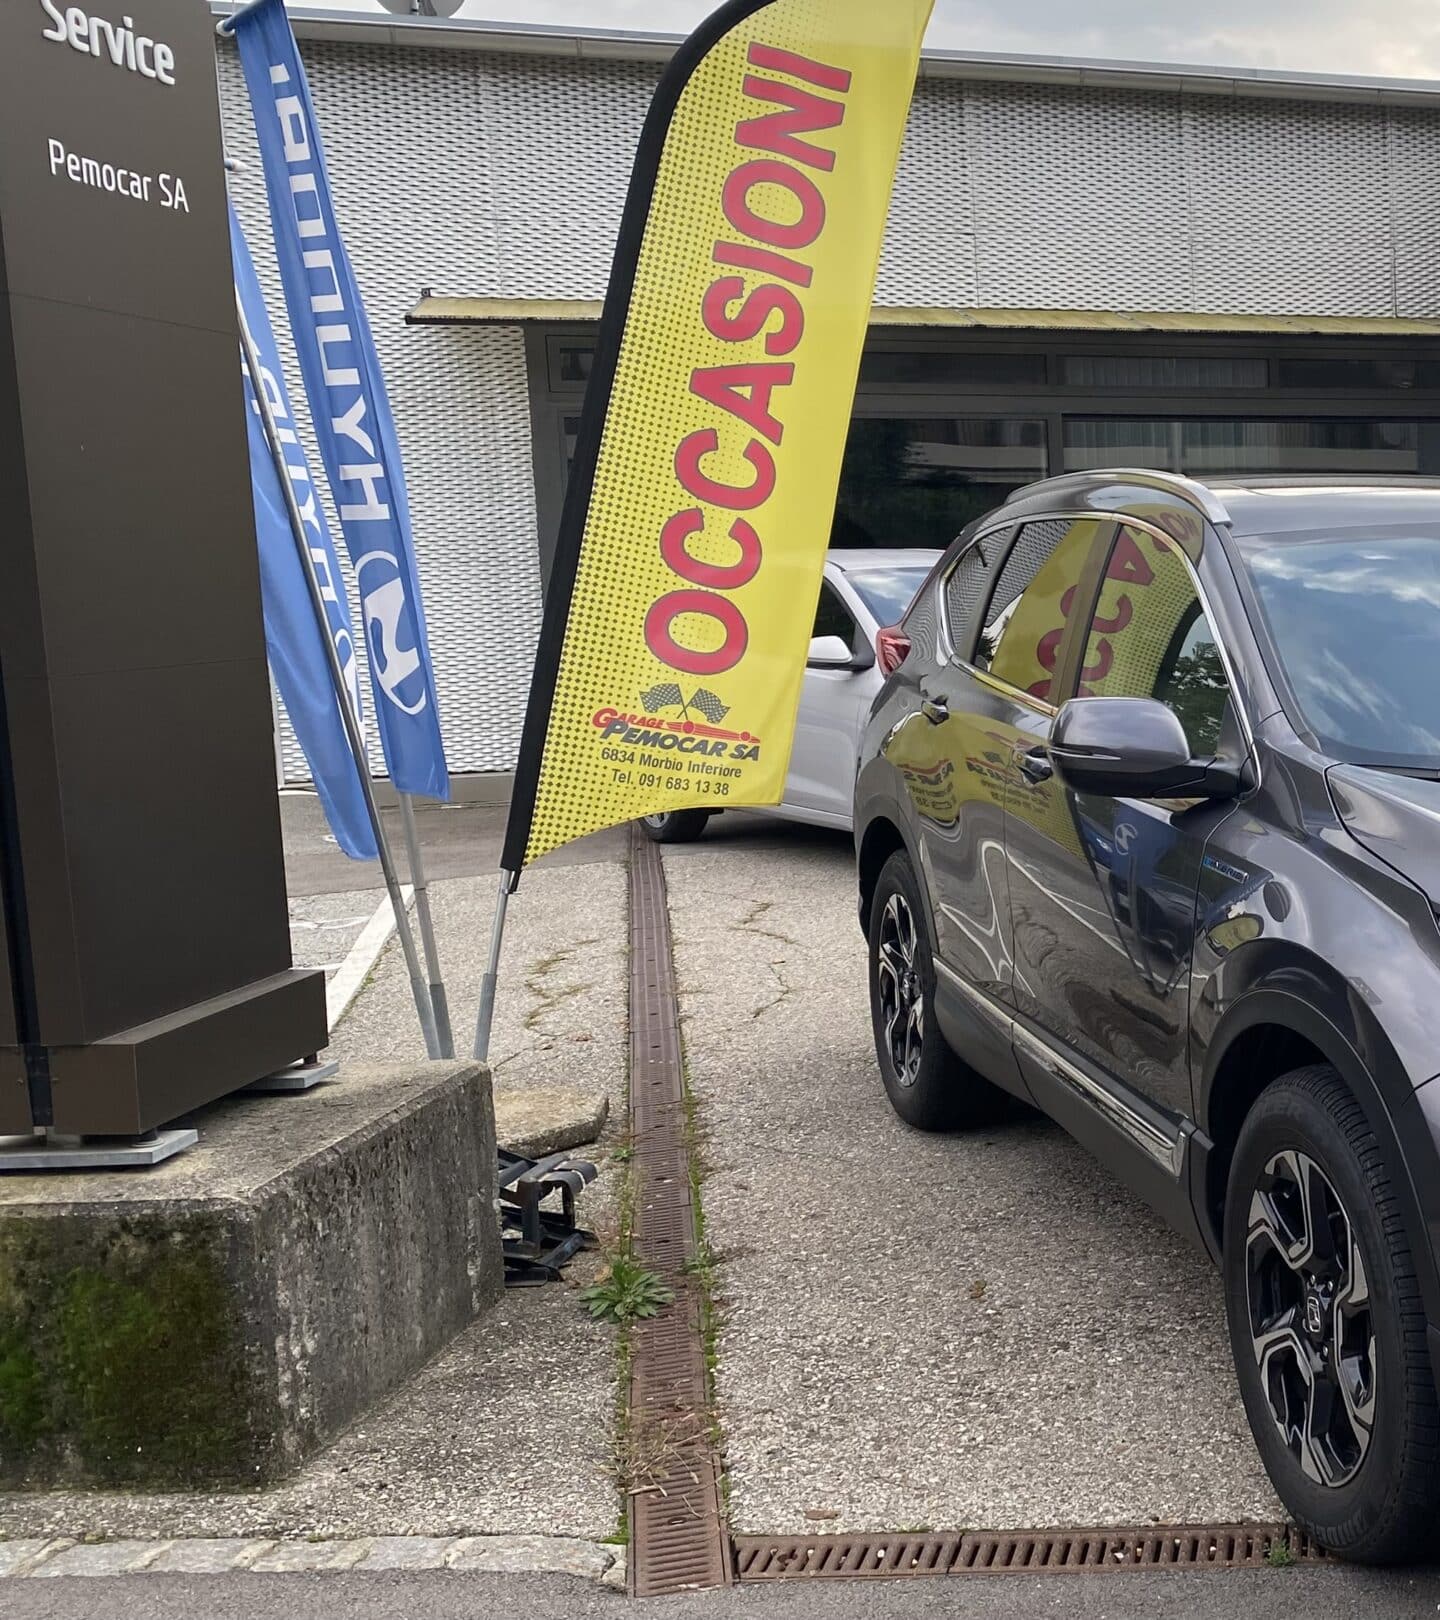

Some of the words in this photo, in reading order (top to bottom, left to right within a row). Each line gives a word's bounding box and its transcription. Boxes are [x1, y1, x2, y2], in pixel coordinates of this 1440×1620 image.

[41, 0, 176, 85] Service
[48, 137, 151, 203] Pemocar
[158, 173, 190, 213] SA
[643, 41, 852, 675] OCCASIONI
[592, 708, 665, 729] GARAGE
[600, 720, 728, 757] PEMOCAR
[728, 743, 761, 761] SA
[601, 747, 635, 764] 6834
[639, 753, 683, 771] Morbio
[688, 760, 742, 778] Inferiore
[611, 769, 634, 785] Tel.
[639, 773, 662, 788] 091
[666, 777, 690, 791] 683
[696, 780, 710, 793] 13
[713, 782, 729, 796] 38
